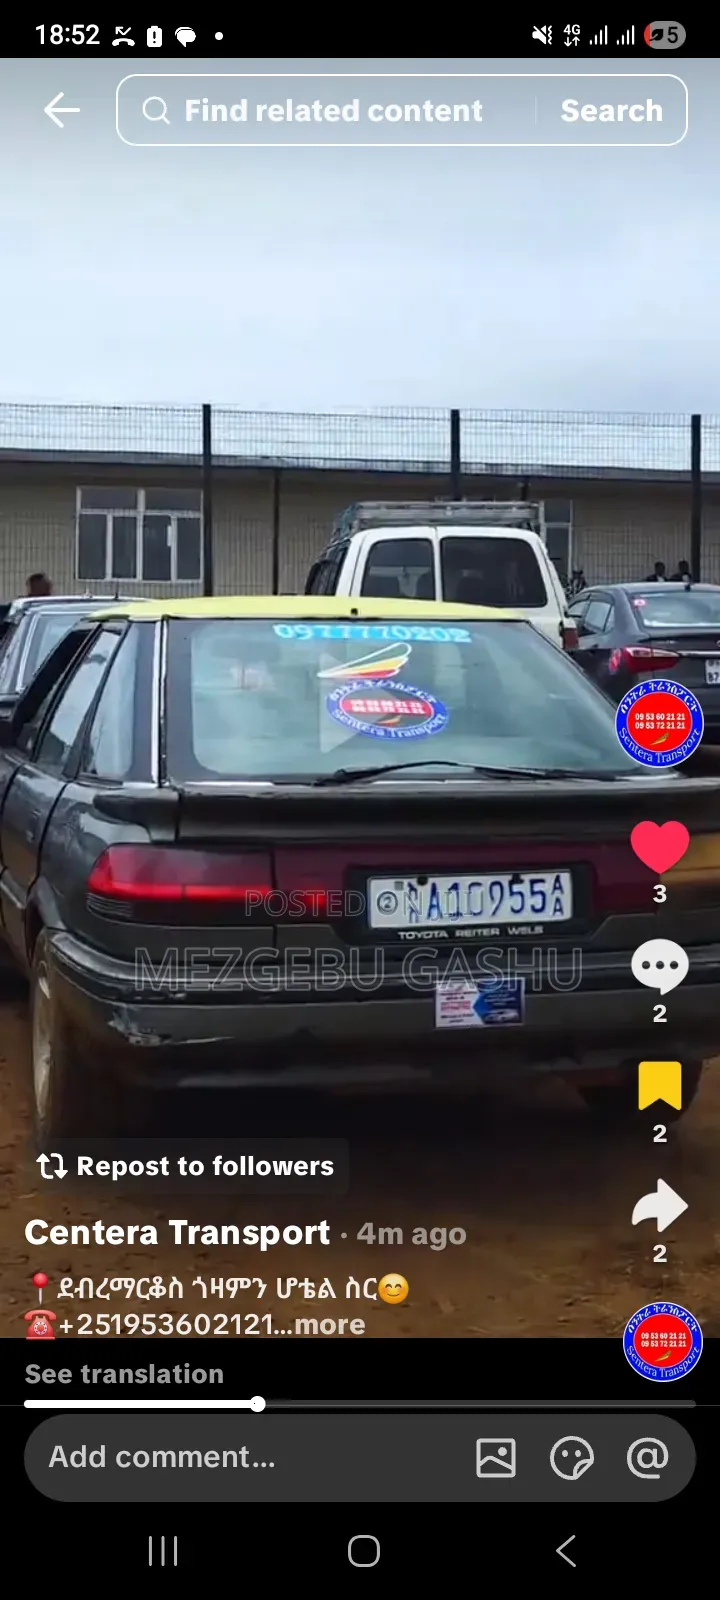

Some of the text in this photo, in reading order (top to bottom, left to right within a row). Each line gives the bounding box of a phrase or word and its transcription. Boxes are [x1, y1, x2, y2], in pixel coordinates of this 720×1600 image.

[273, 624, 472, 643] 0977770202
[398, 930, 449, 940] TOYOTA
[455, 928, 500, 938] REITER
